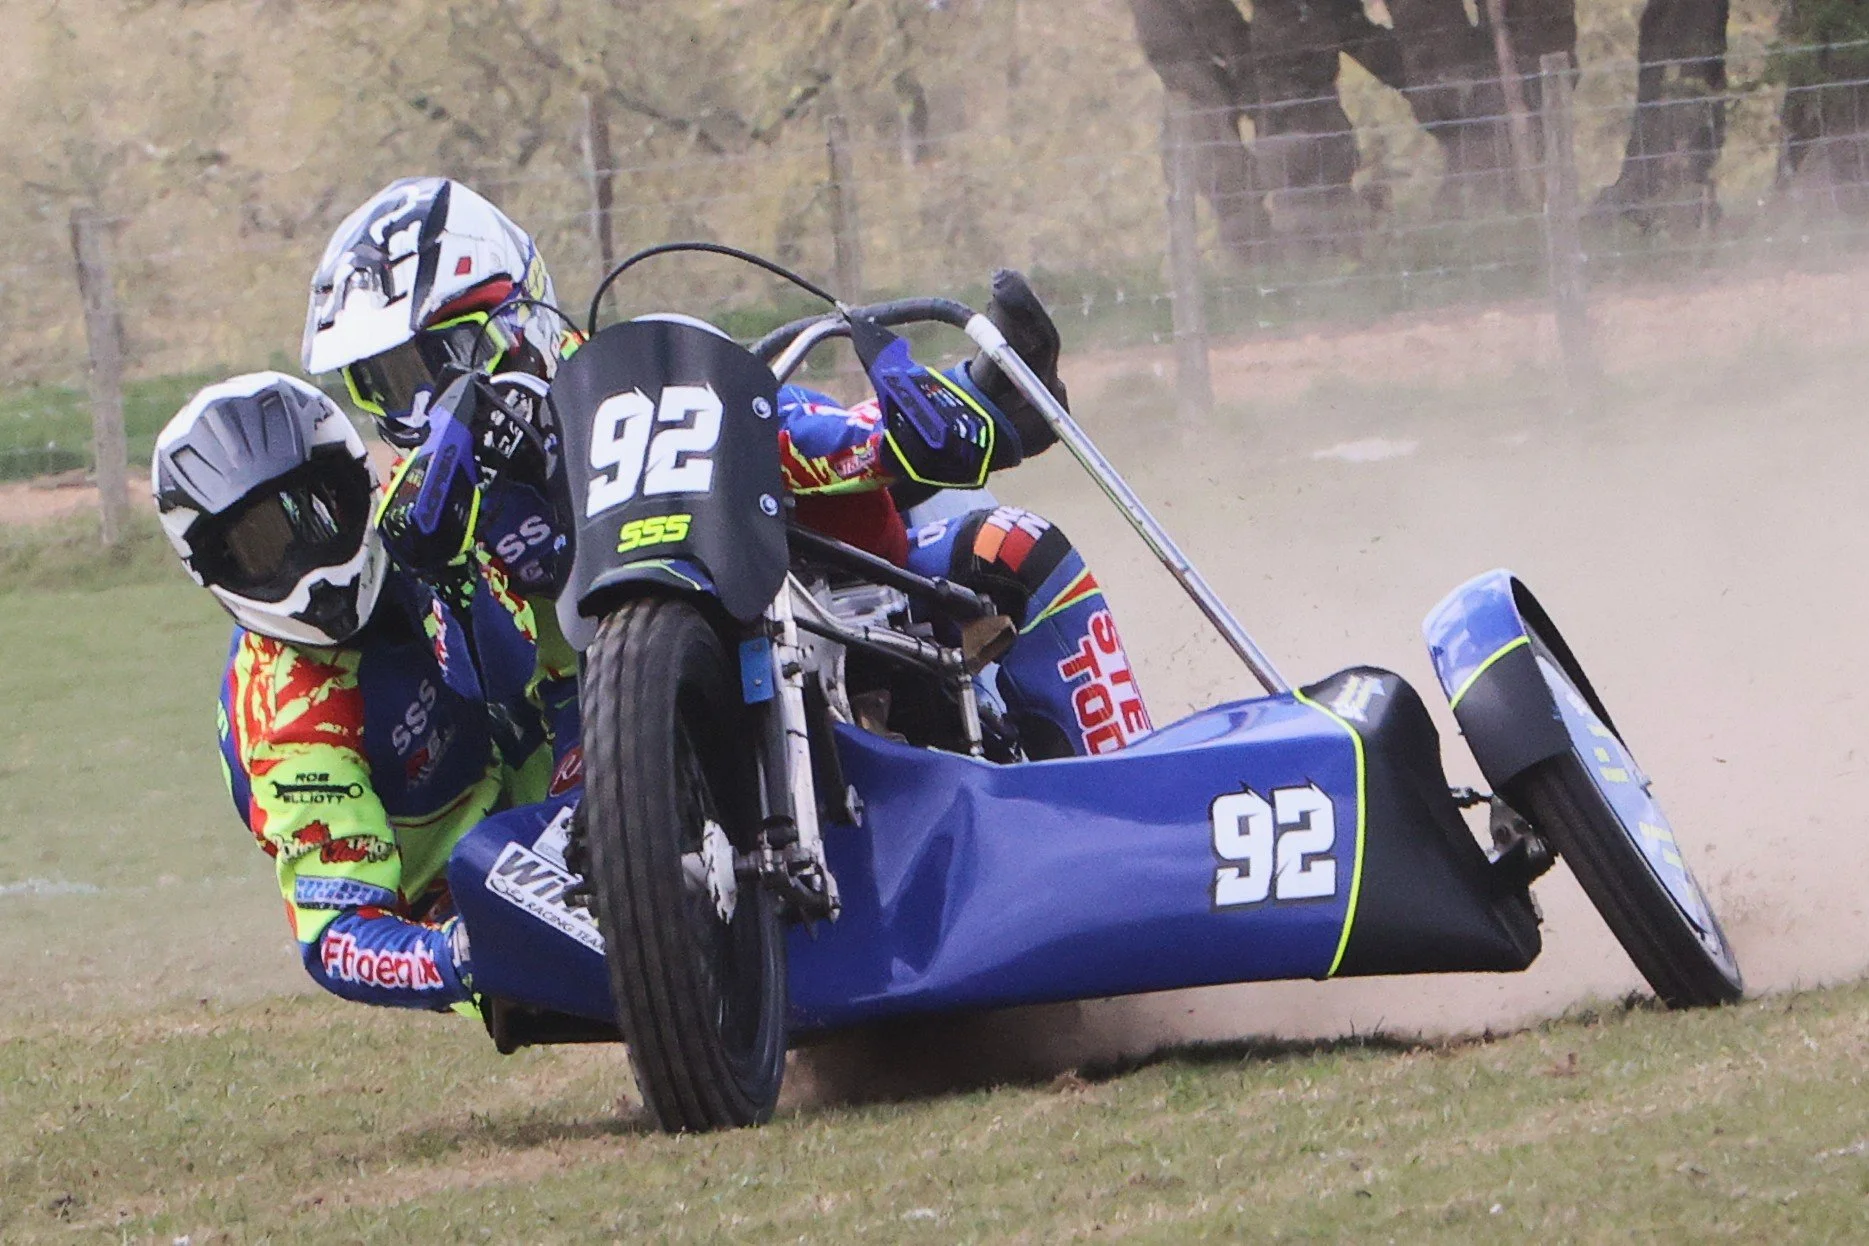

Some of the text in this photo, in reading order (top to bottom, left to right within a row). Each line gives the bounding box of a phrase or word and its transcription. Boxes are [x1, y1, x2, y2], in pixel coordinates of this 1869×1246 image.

[586, 381, 724, 518] 92
[617, 513, 692, 553] SSS
[1209, 780, 1337, 908] 92
